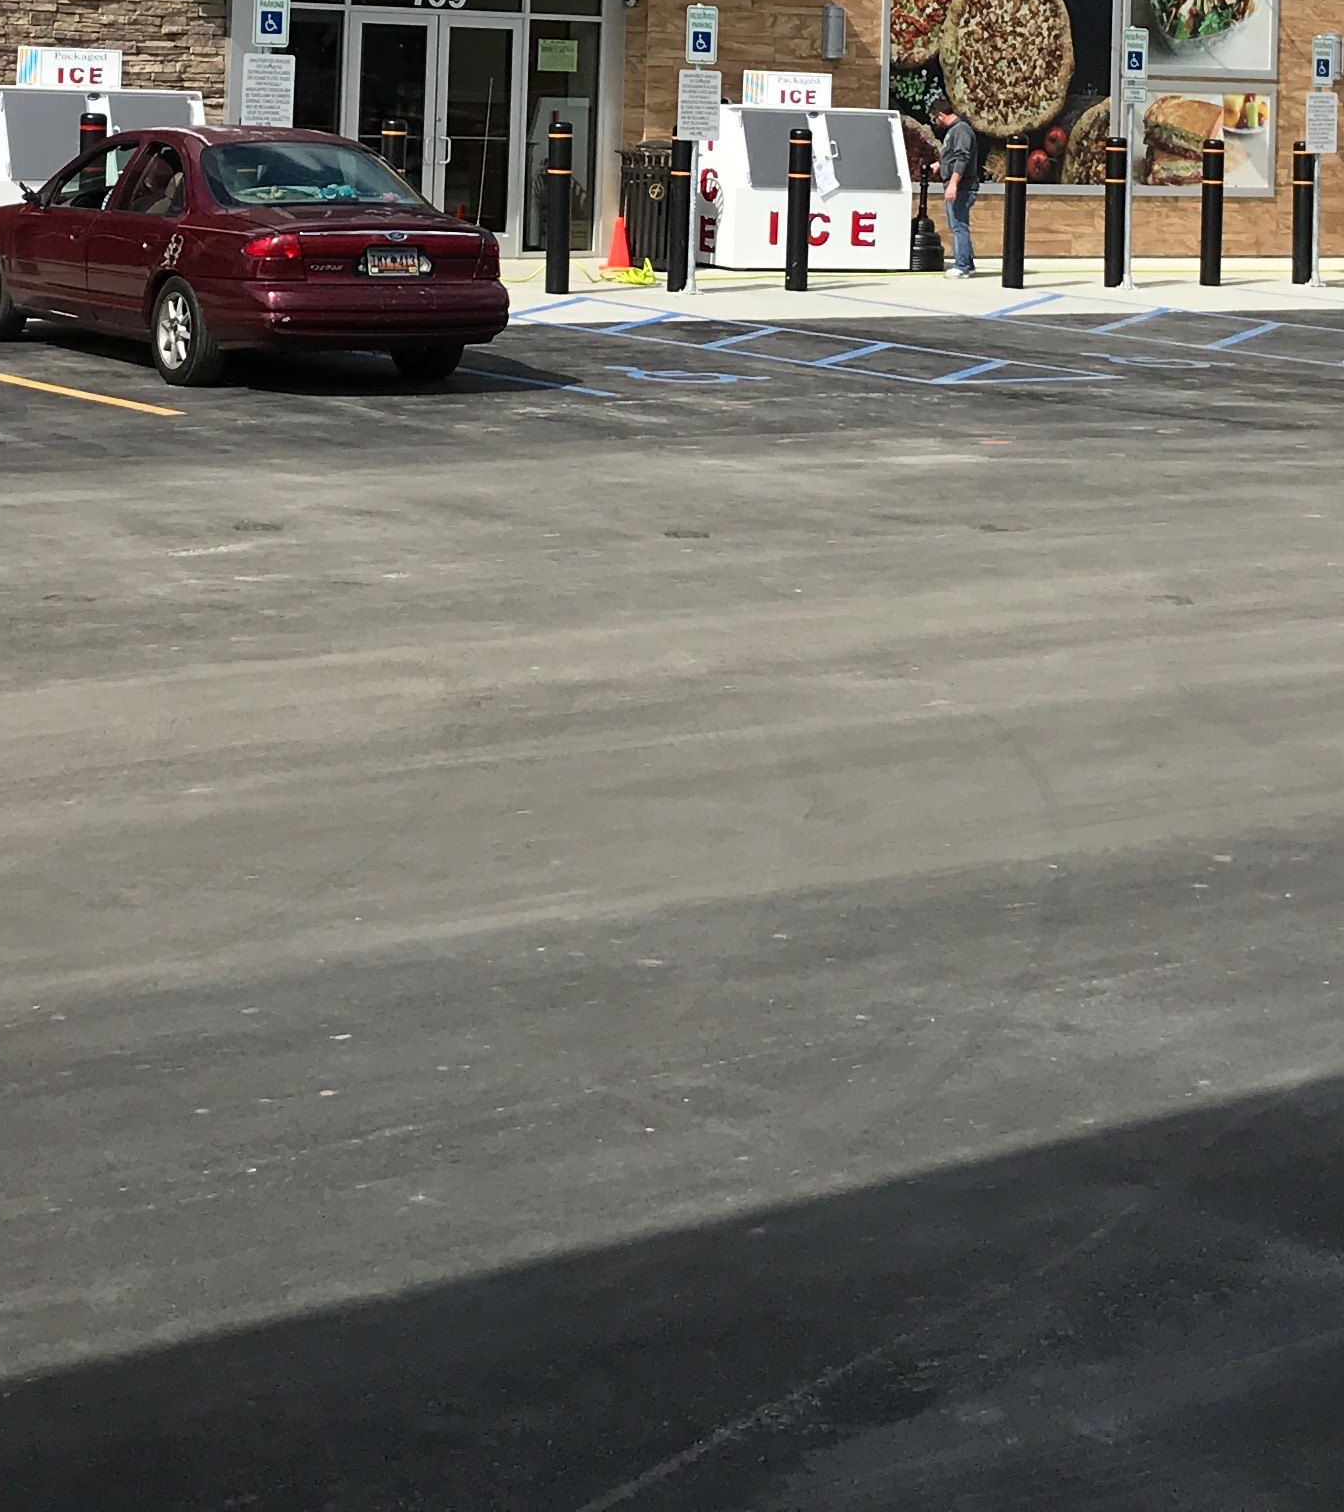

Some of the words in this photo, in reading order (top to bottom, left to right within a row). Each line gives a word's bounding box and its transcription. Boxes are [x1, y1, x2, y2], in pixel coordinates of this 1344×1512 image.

[259, 0, 285, 9] PARKING
[54, 51, 108, 62] Packaged
[57, 66, 103, 85] ICE
[777, 75, 821, 86] Packaged
[780, 89, 817, 105] ICE
[768, 208, 877, 247] ICE
